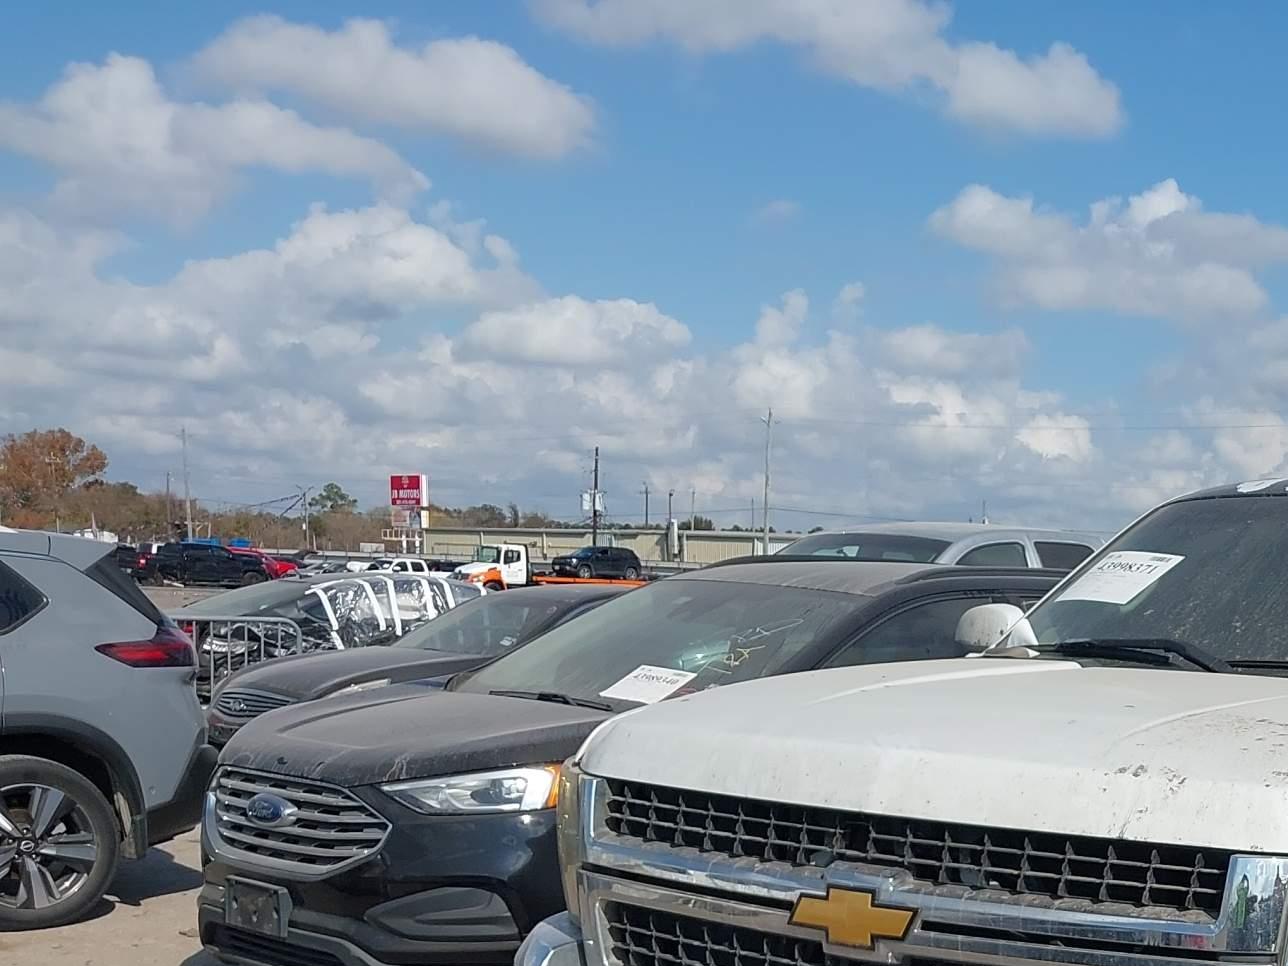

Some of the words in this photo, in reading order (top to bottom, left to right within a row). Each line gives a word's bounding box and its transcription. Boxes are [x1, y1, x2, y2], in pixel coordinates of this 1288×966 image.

[399, 489, 420, 499] MOTORS
[1098, 561, 1159, 575] 43998371
[253, 800, 275, 818] Ford
